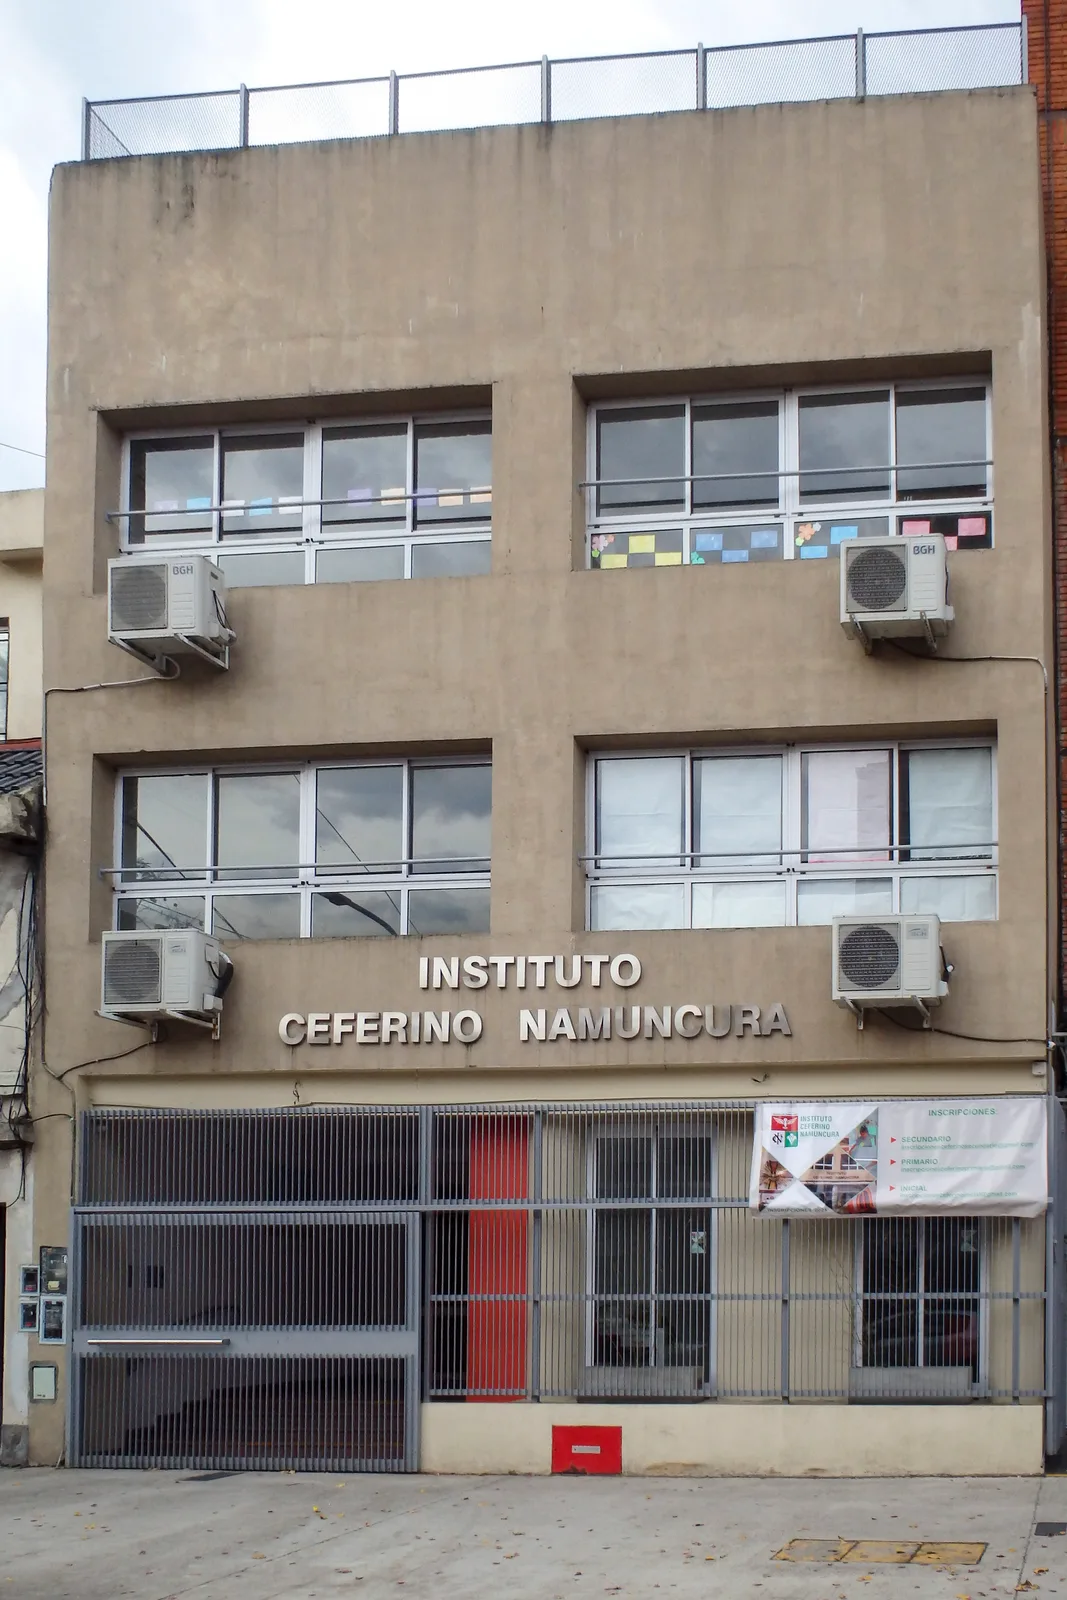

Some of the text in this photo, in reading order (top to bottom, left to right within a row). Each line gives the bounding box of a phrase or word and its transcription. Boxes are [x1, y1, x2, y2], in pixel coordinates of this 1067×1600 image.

[912, 545, 935, 555] BGH
[172, 565, 194, 575] BGH
[418, 953, 642, 989] INSTITUTO
[278, 1003, 793, 1046] CEFERINO NAMUNCURA
